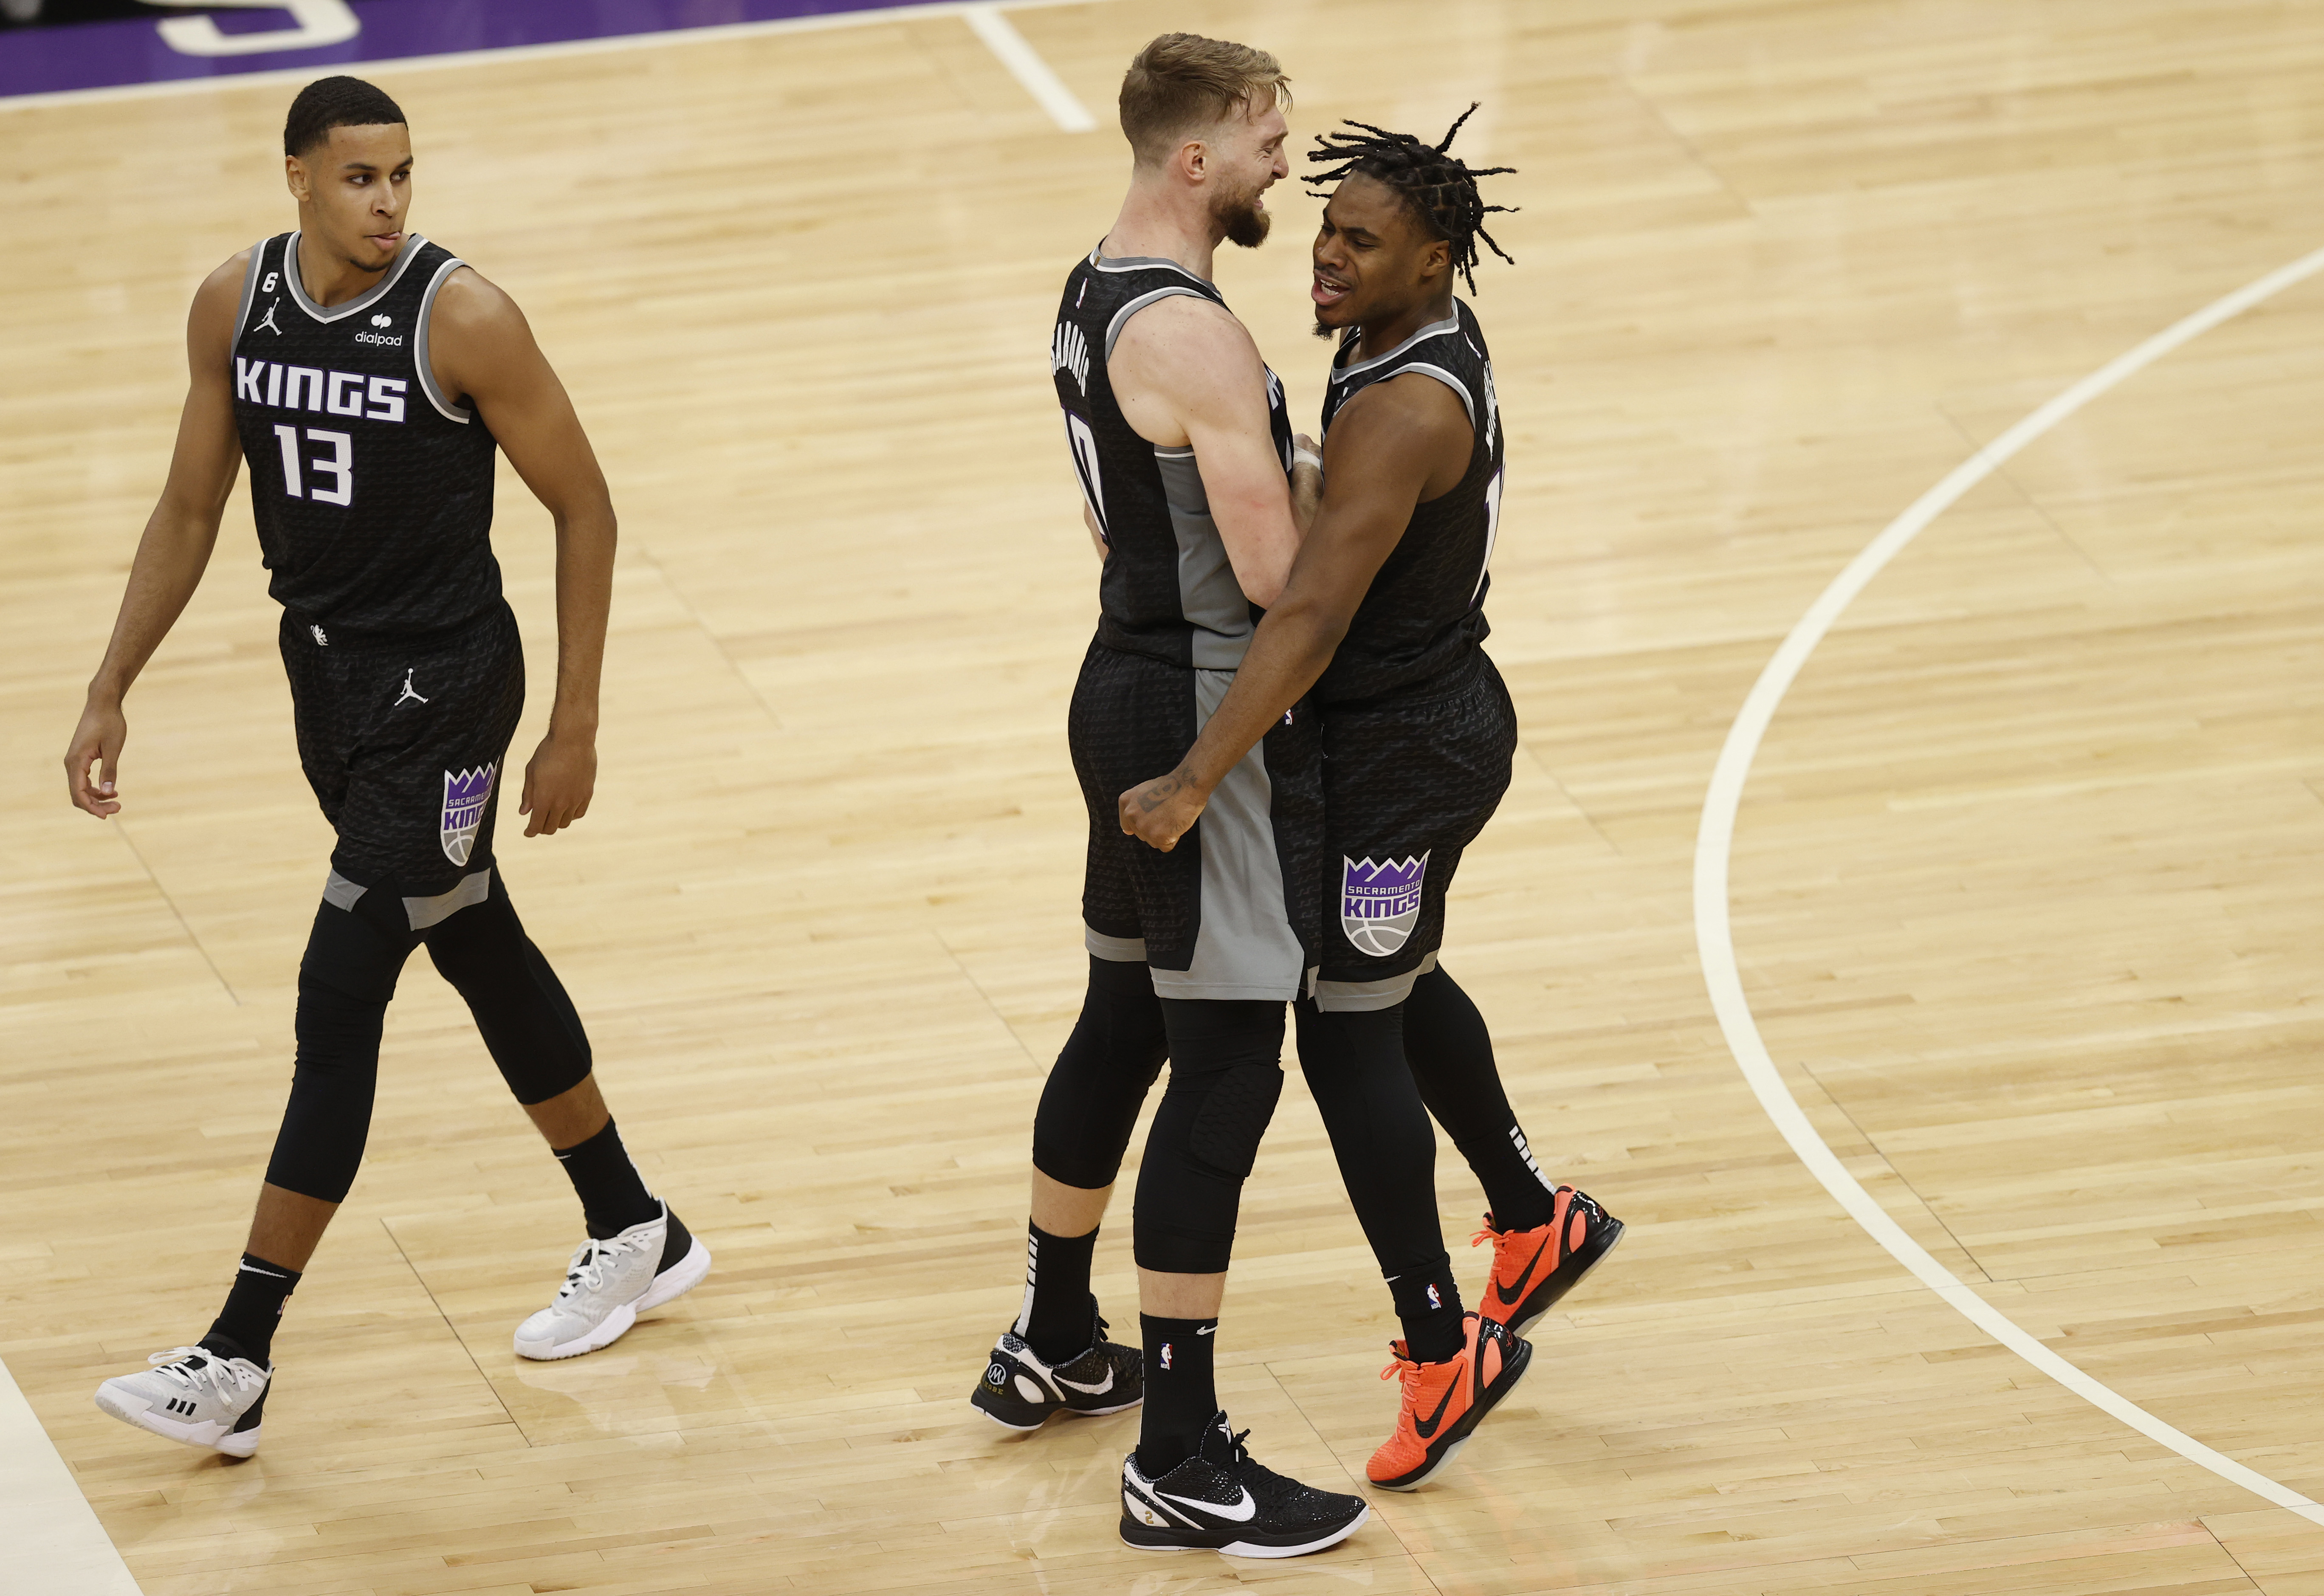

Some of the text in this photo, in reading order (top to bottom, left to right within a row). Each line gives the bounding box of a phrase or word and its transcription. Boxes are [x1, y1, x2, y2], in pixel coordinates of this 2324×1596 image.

[262, 272, 279, 293] 6
[355, 331, 403, 347] dialpad
[235, 356, 409, 424] KINGS
[273, 424, 354, 507] 13
[448, 790, 487, 807] SACRAME
[443, 803, 485, 830] KING
[1348, 879, 1420, 895] SACRAMENTO
[1344, 889, 1420, 918] KINGS
[984, 1381, 1004, 1395] KOBE
[1145, 1511, 1154, 1524] 2
